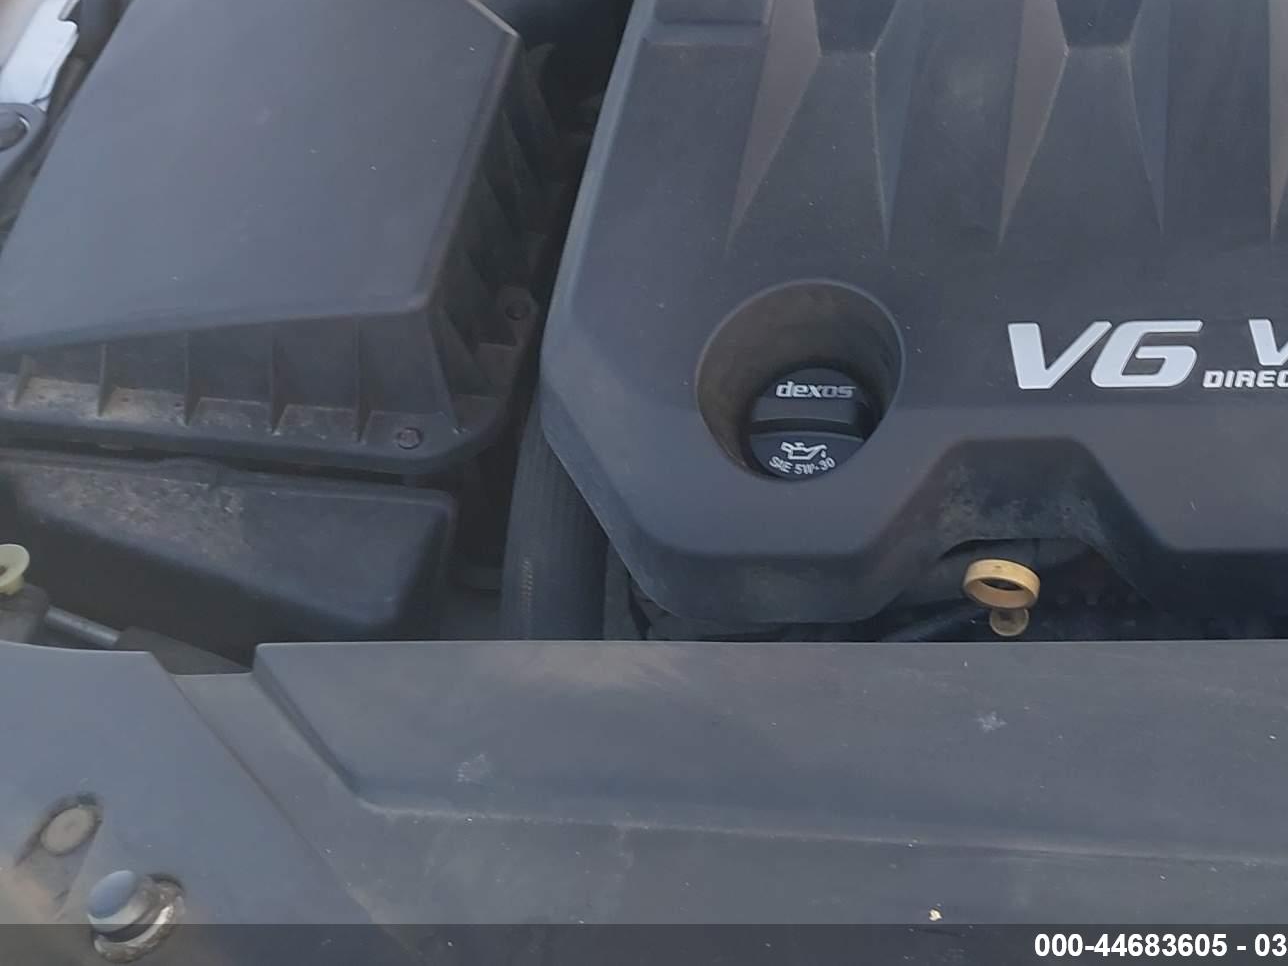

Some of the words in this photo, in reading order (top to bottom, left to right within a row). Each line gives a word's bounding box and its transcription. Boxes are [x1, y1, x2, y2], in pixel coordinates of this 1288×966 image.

[1007, 320, 1203, 389] V6
[776, 381, 856, 398] dexos
[769, 456, 793, 474] SAE
[794, 457, 836, 475] 5W-30
